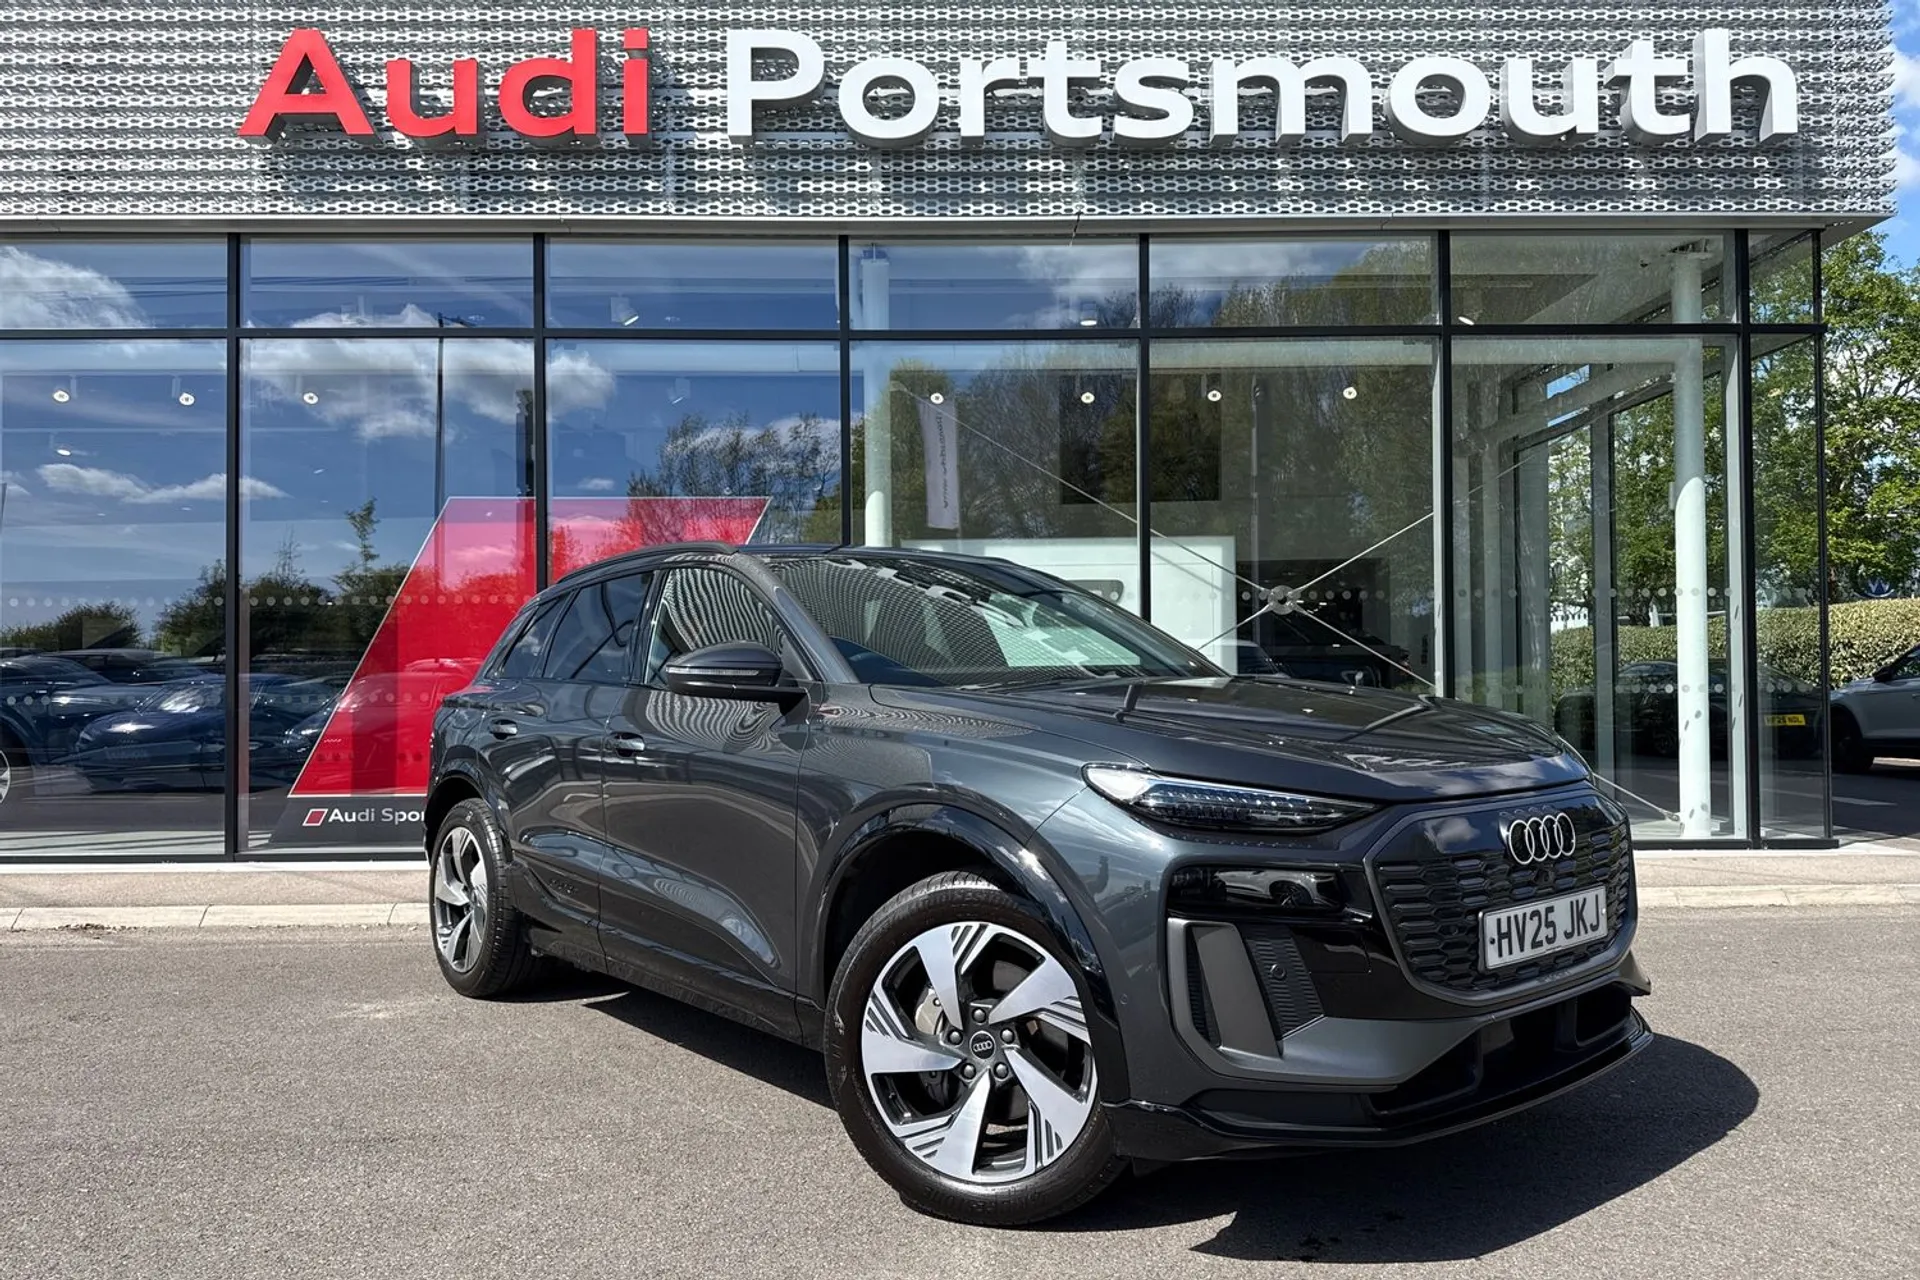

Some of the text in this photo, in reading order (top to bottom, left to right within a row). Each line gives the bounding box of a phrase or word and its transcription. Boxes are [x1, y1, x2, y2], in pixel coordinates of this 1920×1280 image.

[239, 28, 1800, 141] Audi Portsmouth
[328, 808, 425, 825] Audi Spor
[1497, 894, 1600, 958] HV25 JKJ
